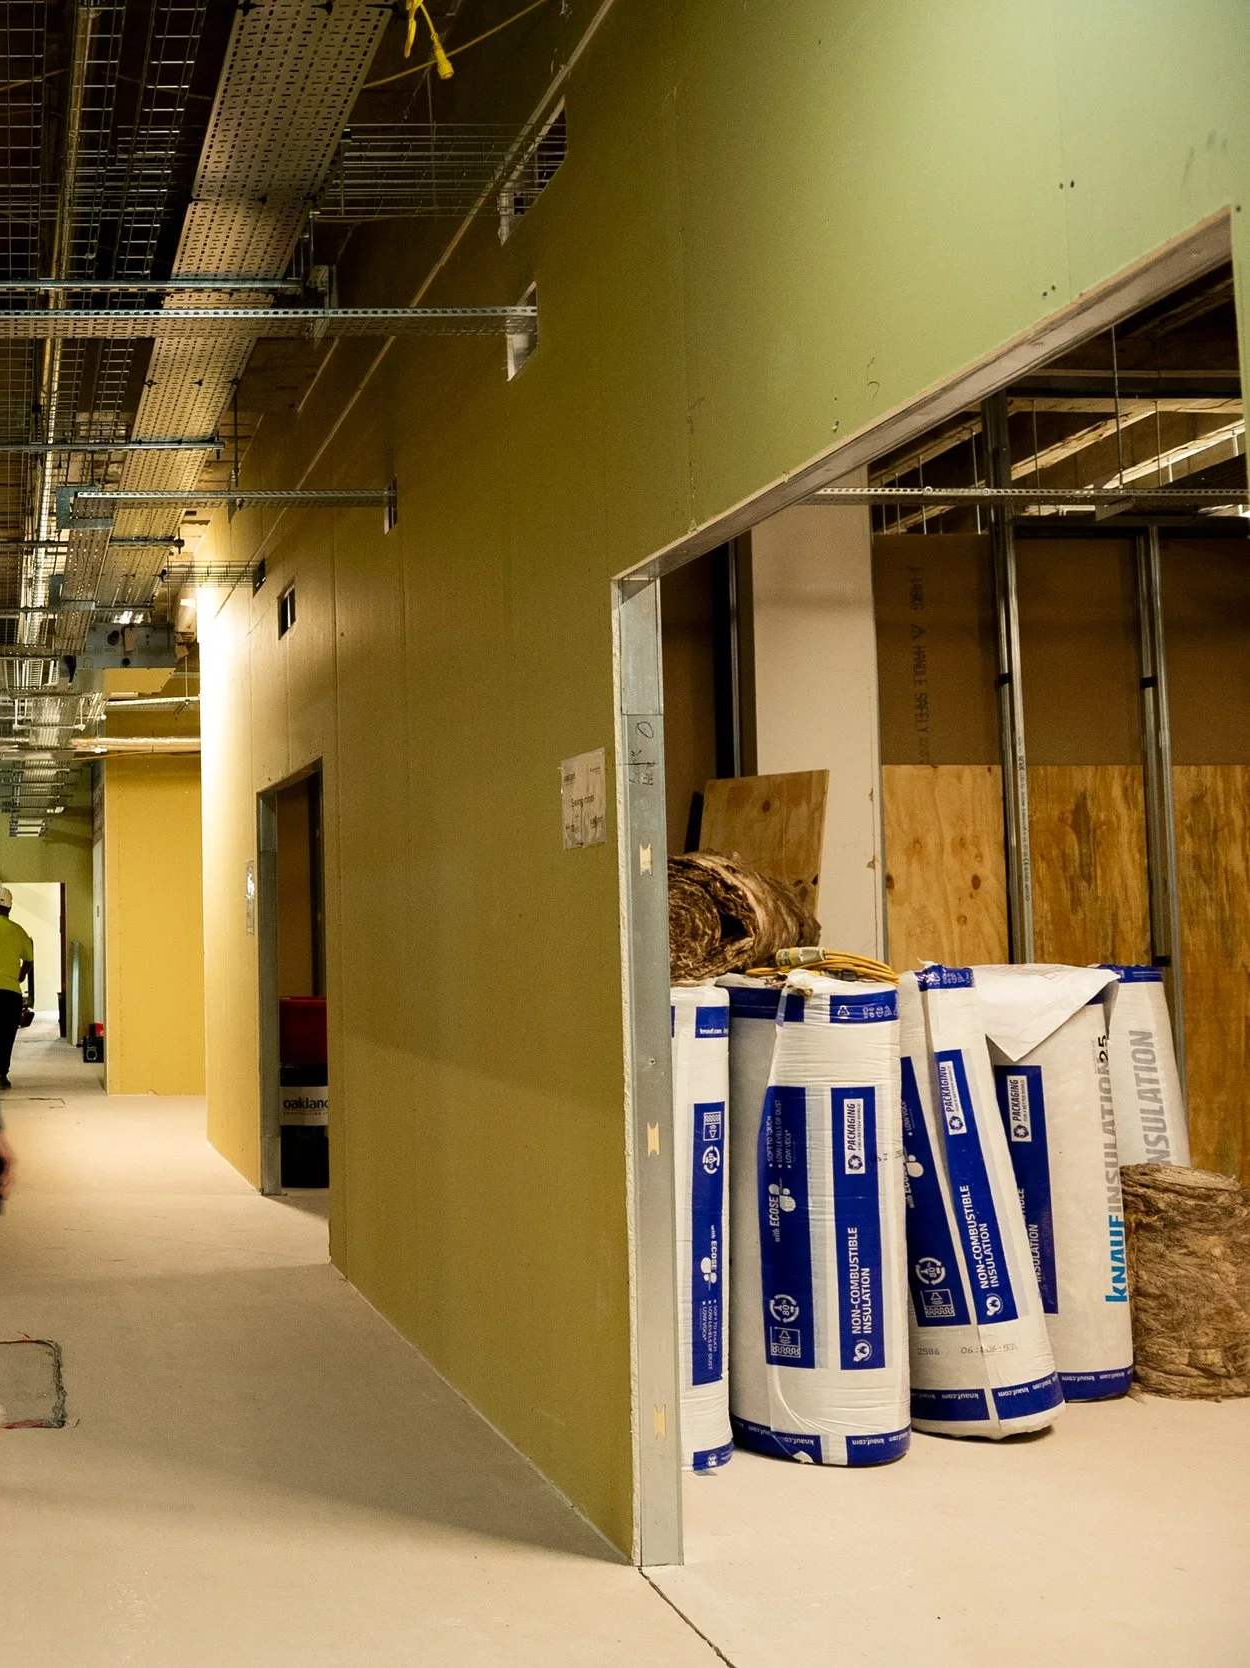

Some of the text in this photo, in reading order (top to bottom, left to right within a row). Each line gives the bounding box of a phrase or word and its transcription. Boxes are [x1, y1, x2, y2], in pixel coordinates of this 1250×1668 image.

[1097, 1035, 1109, 1063] 25
[939, 1066, 955, 1113] PACKAGING
[1009, 1079, 1022, 1122] PACKAGING
[1128, 1030, 1172, 1166] NSULATION
[846, 1103, 856, 1151] PACKAGING
[768, 1196, 781, 1243] with ECOSE
[959, 1185, 990, 1289] NON-COMBUSTIBLE
[978, 1223, 1000, 1288] INSULATION
[847, 1227, 862, 1334] NON-COMBUSTIBLE
[861, 1267, 872, 1334] INSULATION
[941, 1393, 979, 1401] knauf.com
[998, 1387, 1030, 1397] knauf.com
[852, 1437, 885, 1446] knauf.com
